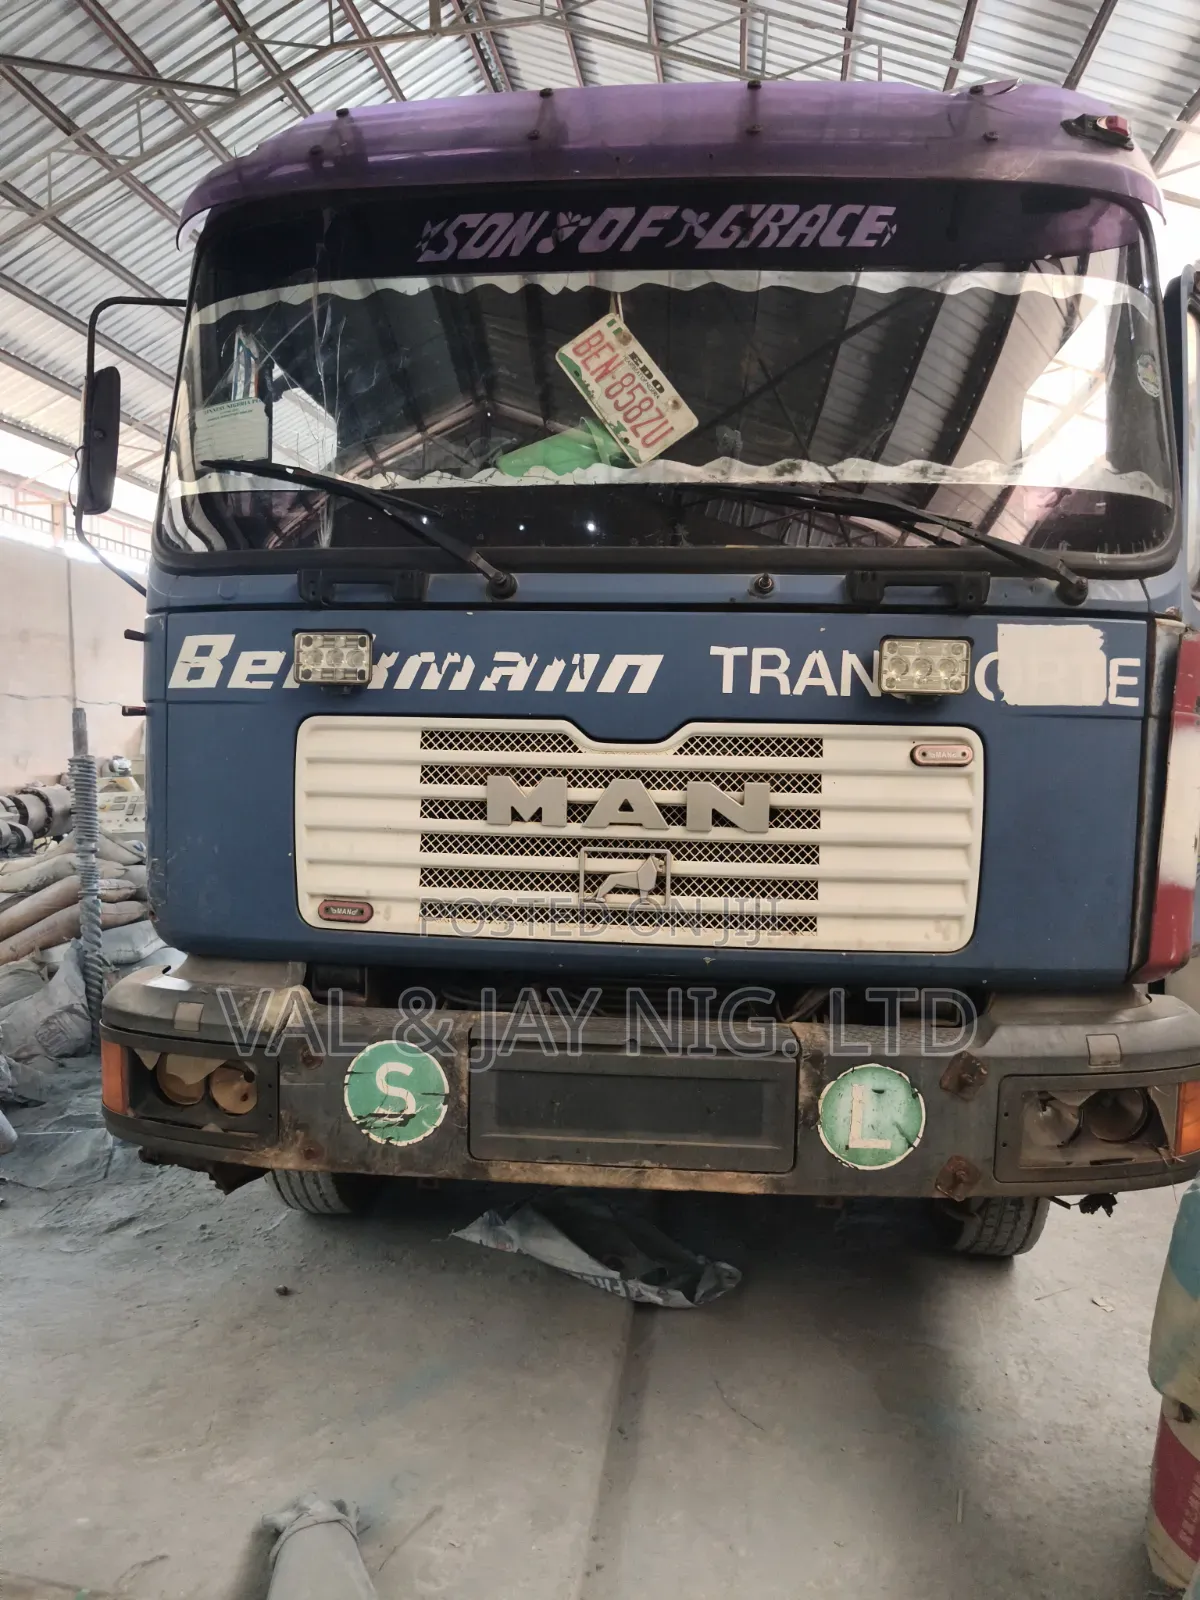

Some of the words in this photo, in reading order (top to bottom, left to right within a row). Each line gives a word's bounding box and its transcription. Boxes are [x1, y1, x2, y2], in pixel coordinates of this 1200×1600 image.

[416, 211, 549, 263] SON
[579, 204, 684, 252] OF
[695, 203, 897, 249] GRACE
[628, 351, 665, 394] EDO
[486, 774, 771, 834] MAN
[375, 1061, 417, 1124] S
[848, 1083, 892, 1150] L
